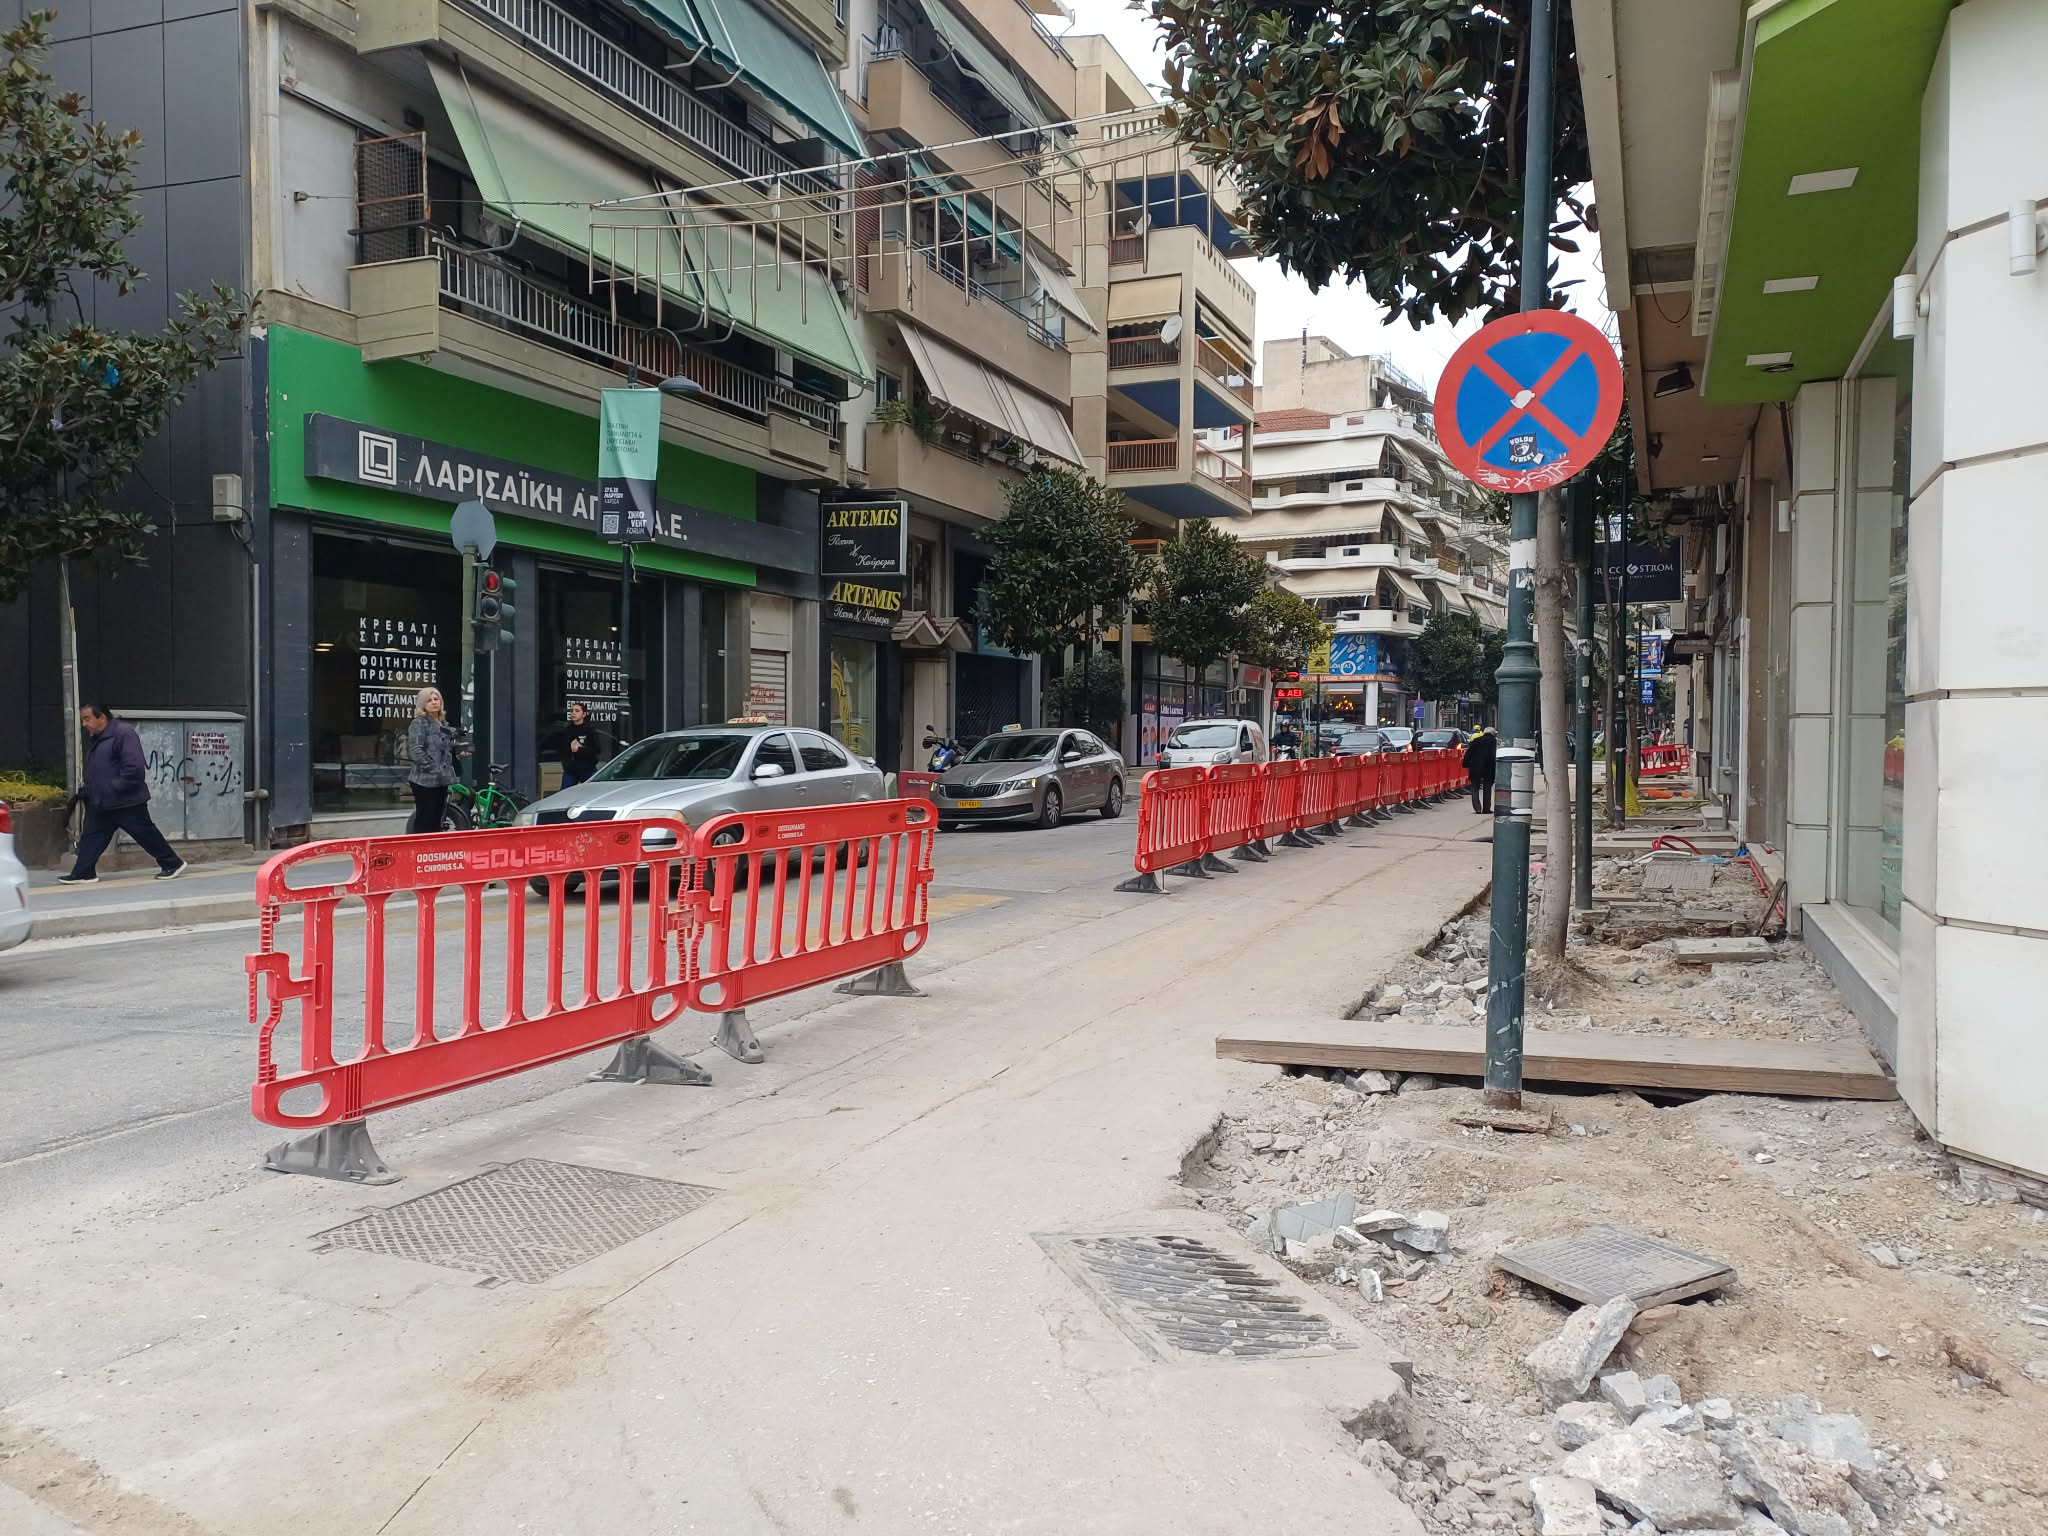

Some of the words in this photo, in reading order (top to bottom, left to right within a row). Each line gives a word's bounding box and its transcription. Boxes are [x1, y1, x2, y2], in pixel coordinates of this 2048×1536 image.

[827, 509, 898, 527] ARTEMIS
[1639, 563, 1673, 572] STROM
[829, 581, 901, 611] ARTEMIS
[360, 618, 436, 635] ΚΡΕΒΑΤΙ
[360, 631, 437, 647] ΣΤΡΩΜΑ
[567, 637, 622, 651] ΚΡΕΒΑΤΙ
[360, 655, 437, 670] ΦΟΙΤΗΤΙΚΕΣ
[567, 649, 621, 662] ΣΤΡΩΜΑ
[360, 669, 437, 683] ΠΡΟΣΦΟΡΕΣ
